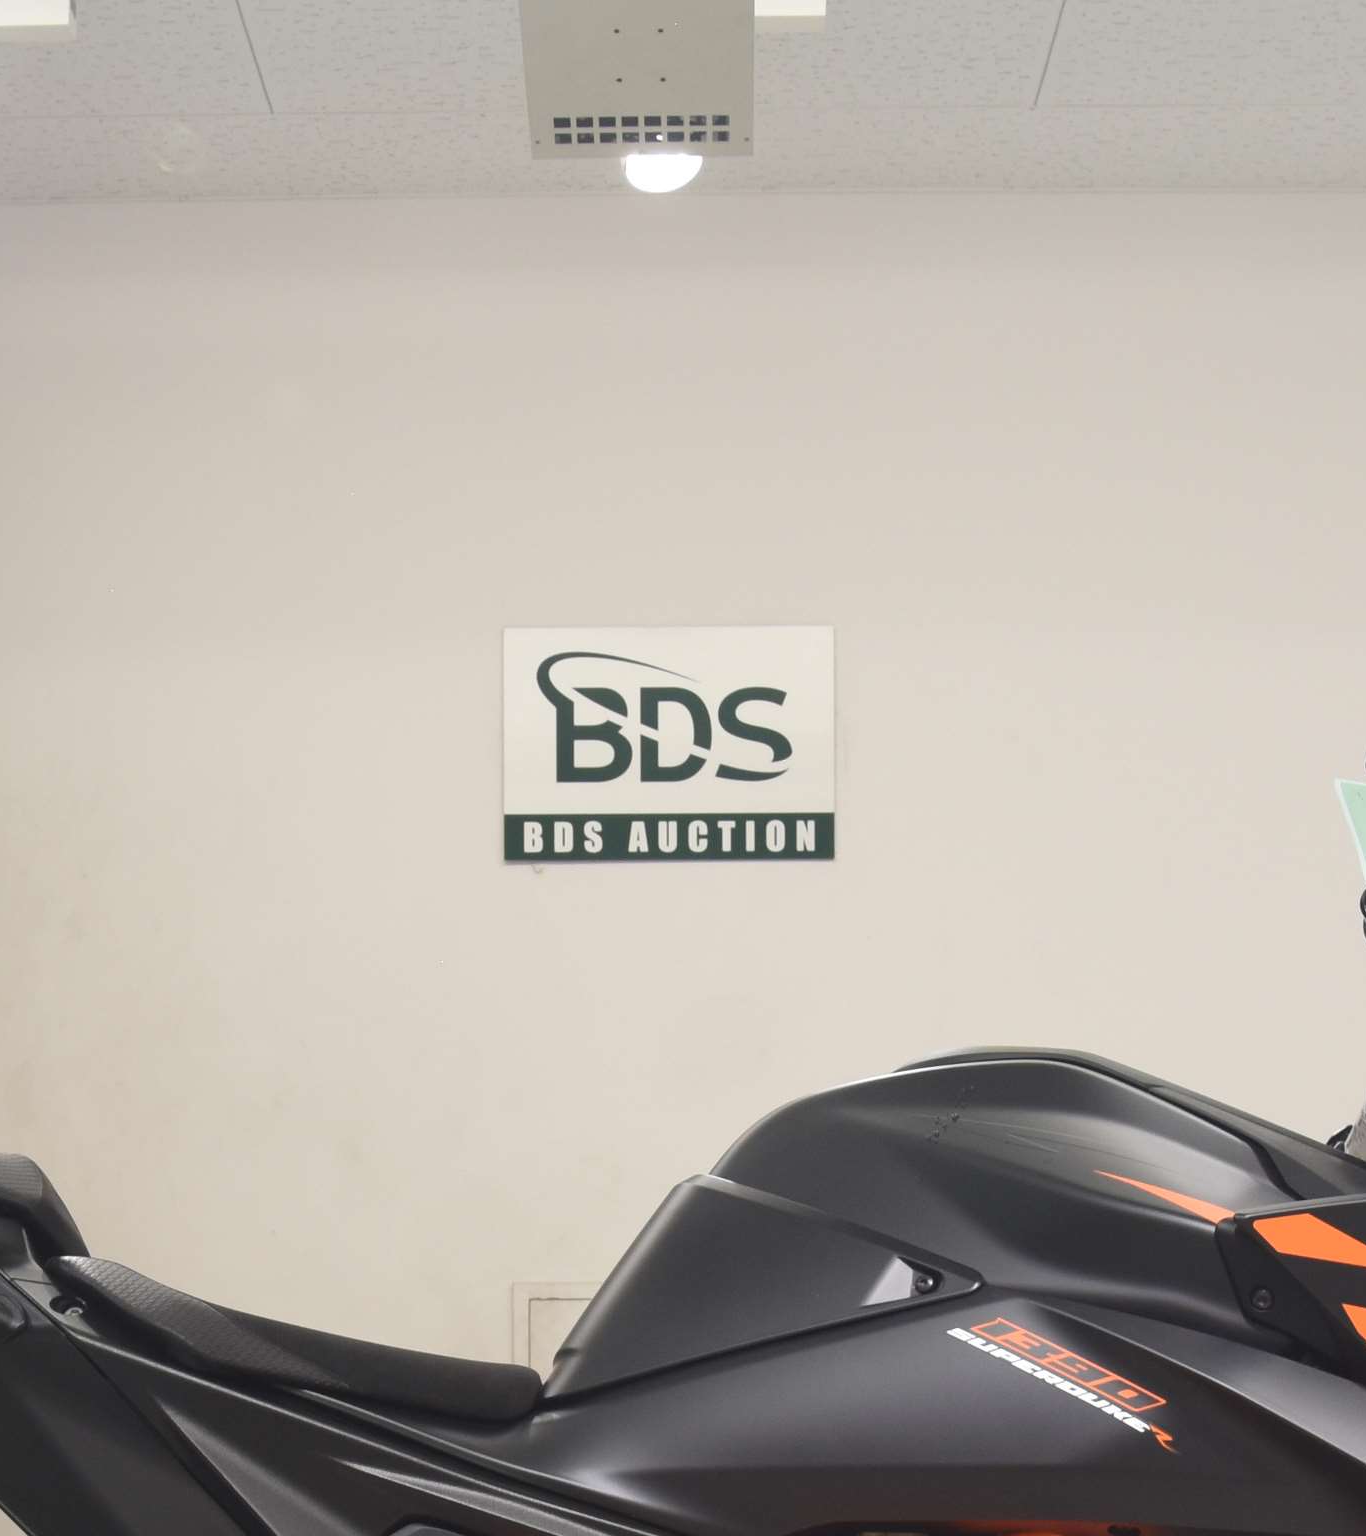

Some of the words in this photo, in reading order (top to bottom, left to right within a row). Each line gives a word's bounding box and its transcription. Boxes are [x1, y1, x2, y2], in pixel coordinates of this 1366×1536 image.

[536, 651, 793, 783] BDS
[522, 820, 604, 854] BDS
[627, 819, 816, 853] AUCTION
